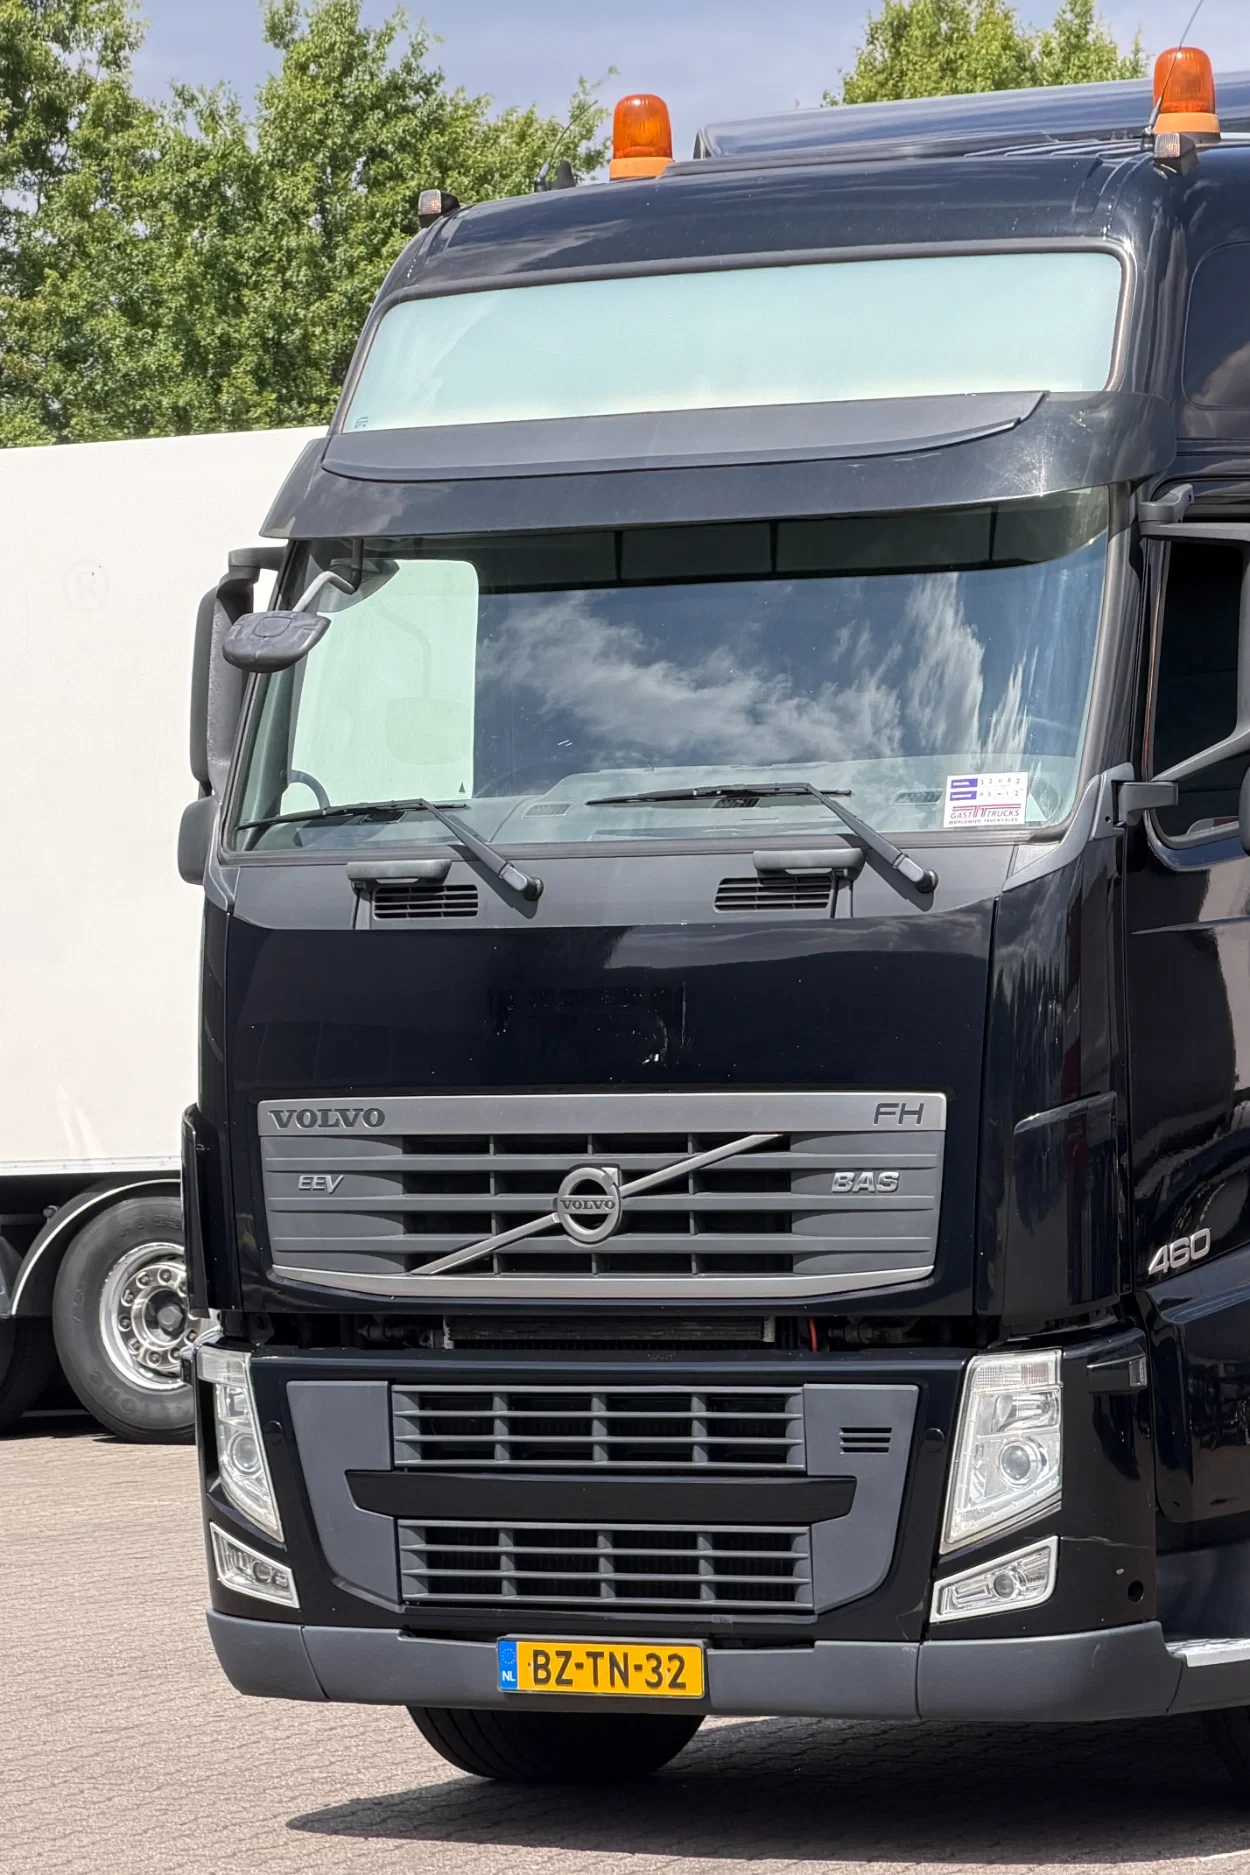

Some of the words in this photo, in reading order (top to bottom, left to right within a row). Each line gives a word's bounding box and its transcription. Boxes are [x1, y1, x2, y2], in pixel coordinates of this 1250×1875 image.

[268, 1107, 386, 1129] VOLVO
[873, 1103, 925, 1125] FH
[298, 1174, 344, 1194] EEV
[831, 1171, 899, 1193] BAS
[561, 1200, 616, 1210] VOLVO
[1148, 1227, 1211, 1275] 460
[502, 1670, 516, 1682] NL
[532, 1649, 687, 1690] BZ-TN-32
